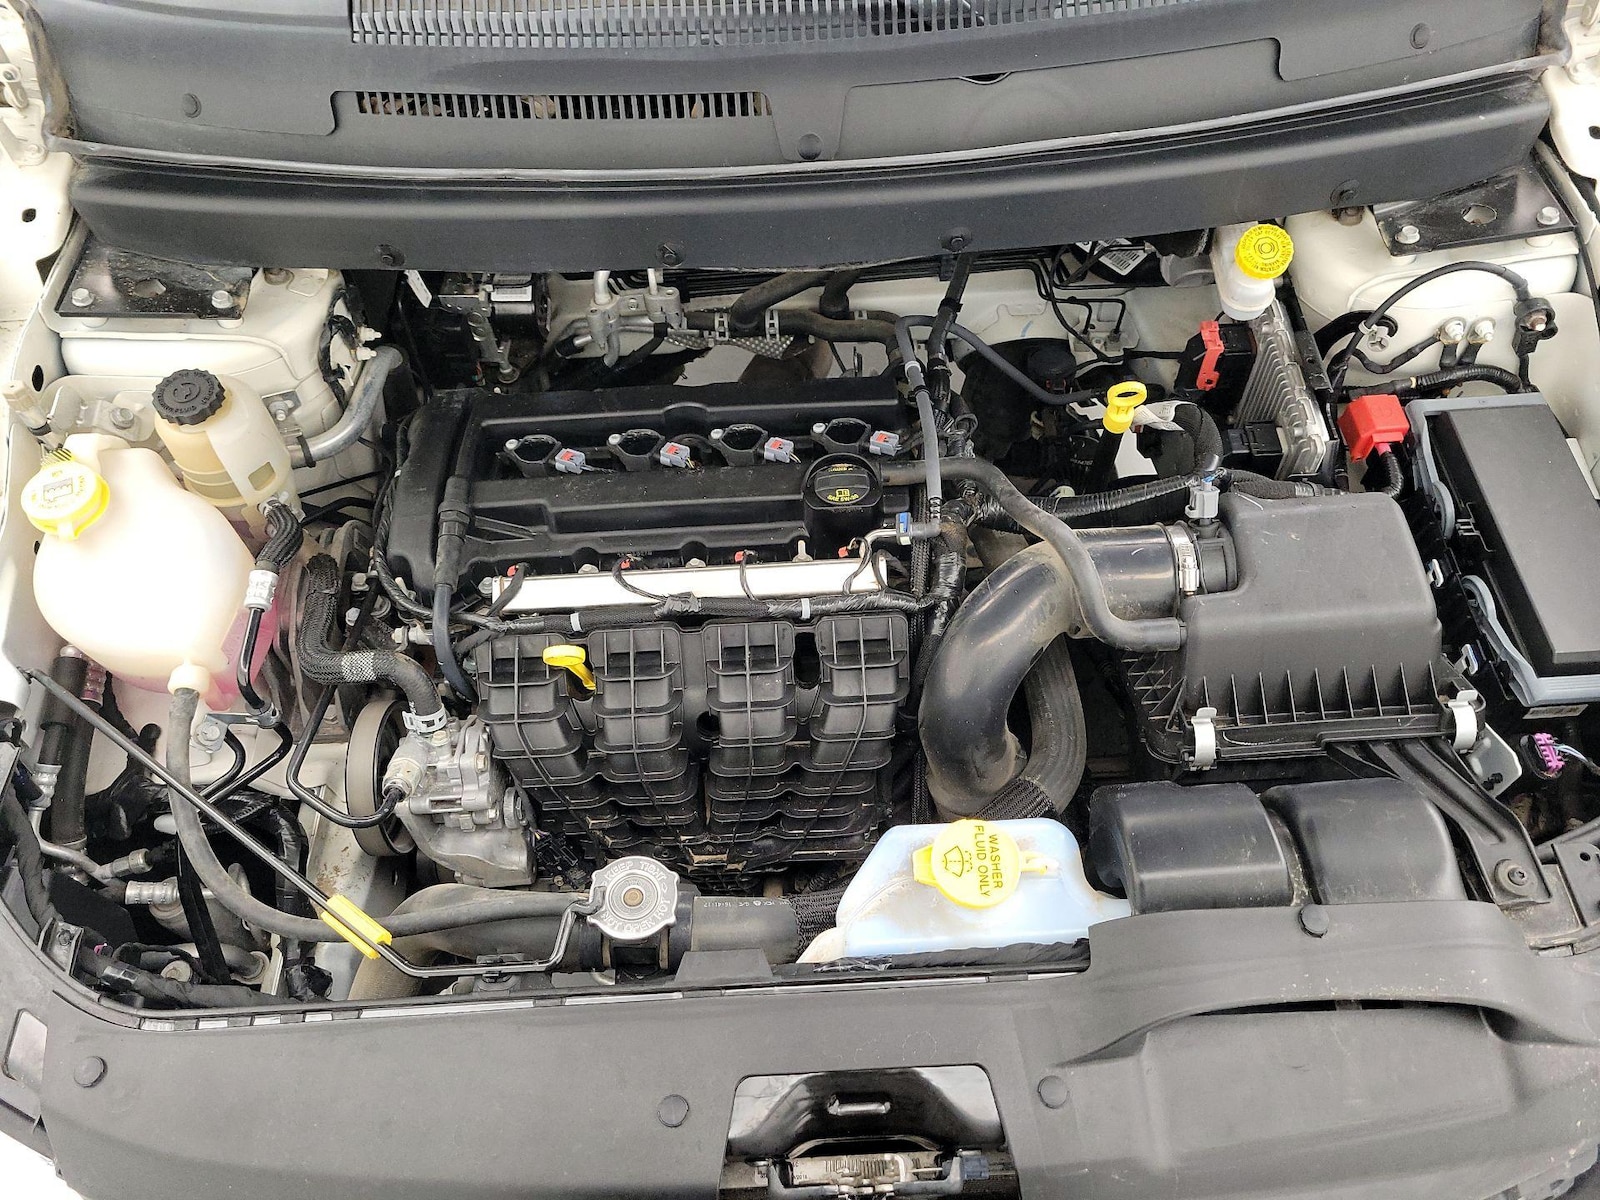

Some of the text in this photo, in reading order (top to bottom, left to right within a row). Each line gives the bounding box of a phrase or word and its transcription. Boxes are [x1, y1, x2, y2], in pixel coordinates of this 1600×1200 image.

[604, 860, 668, 881] KEEP TIGHT
[974, 825, 990, 897] FLUID ONLY
[988, 834, 1003, 889] WASHER
[600, 911, 622, 930] NOT
[655, 899, 671, 921] HOT
